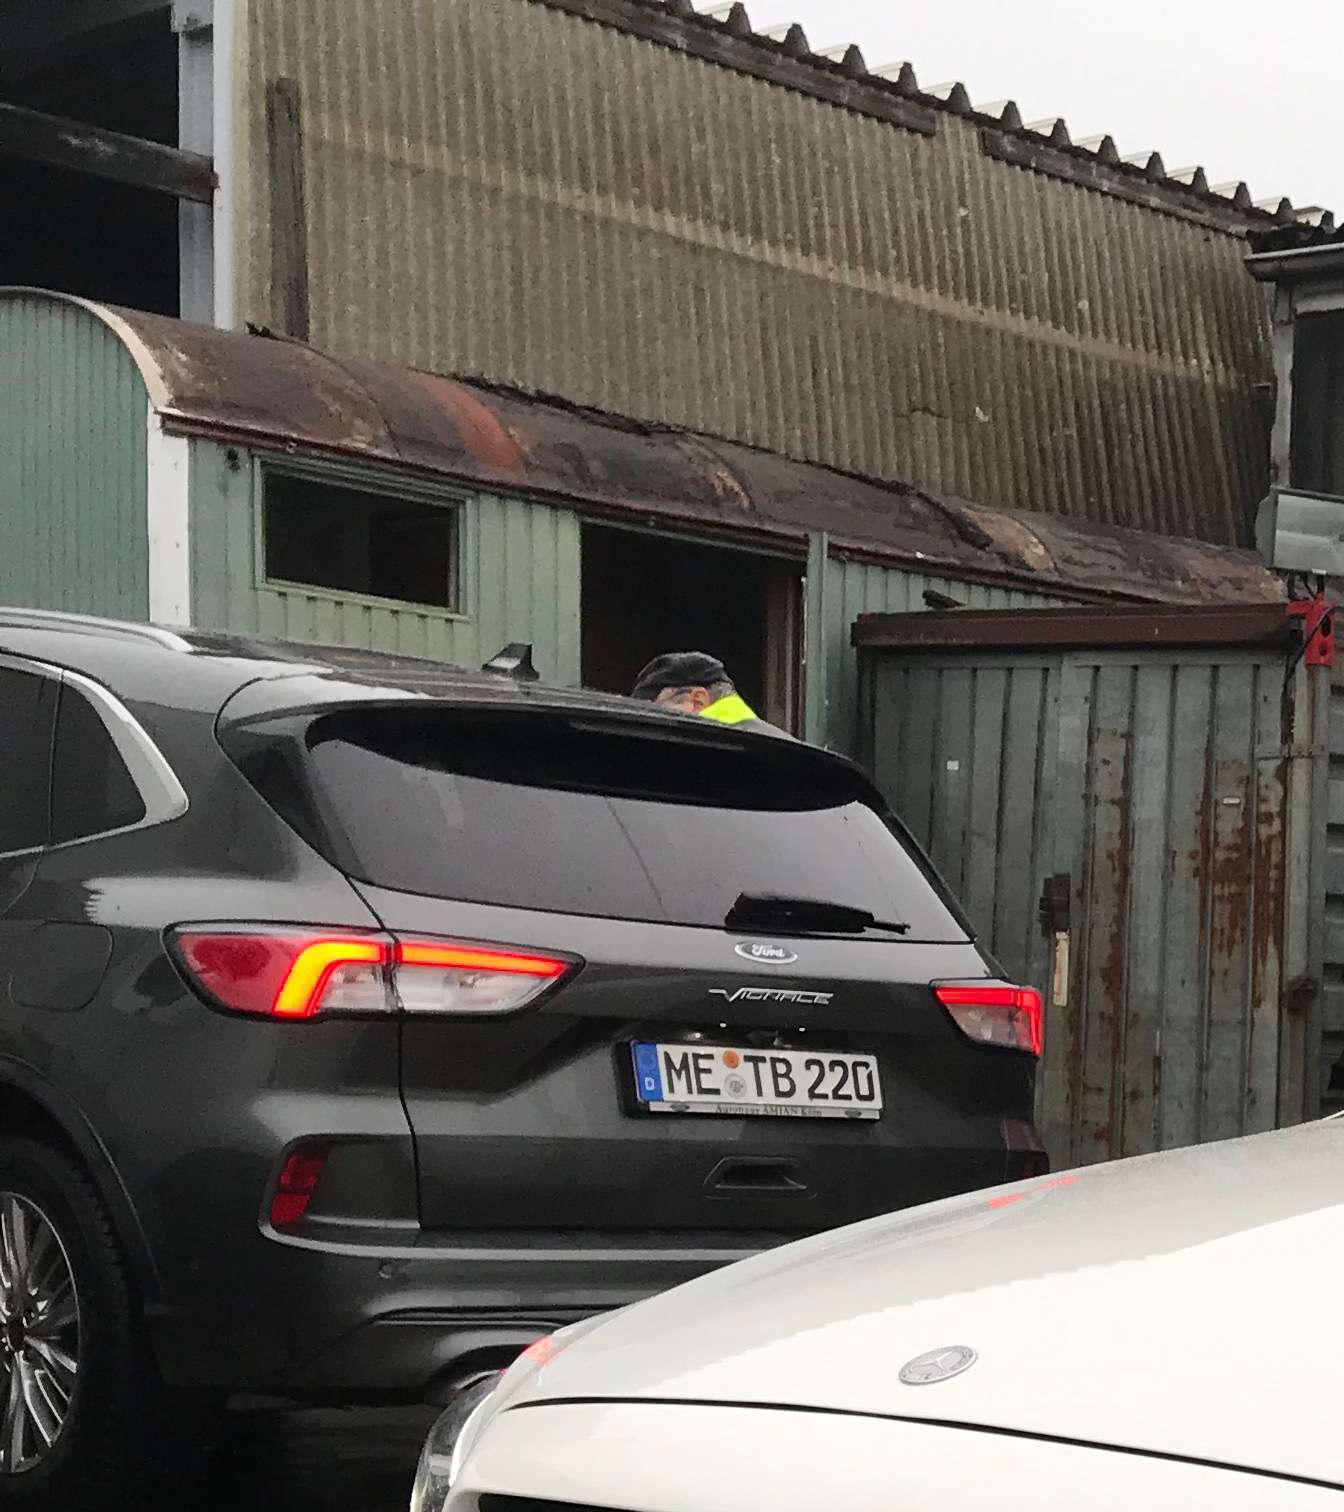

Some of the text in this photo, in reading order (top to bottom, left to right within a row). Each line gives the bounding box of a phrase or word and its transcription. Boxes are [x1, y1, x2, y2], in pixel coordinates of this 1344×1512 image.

[752, 943, 786, 957] Ford
[663, 1051, 875, 1102] ME TB 220
